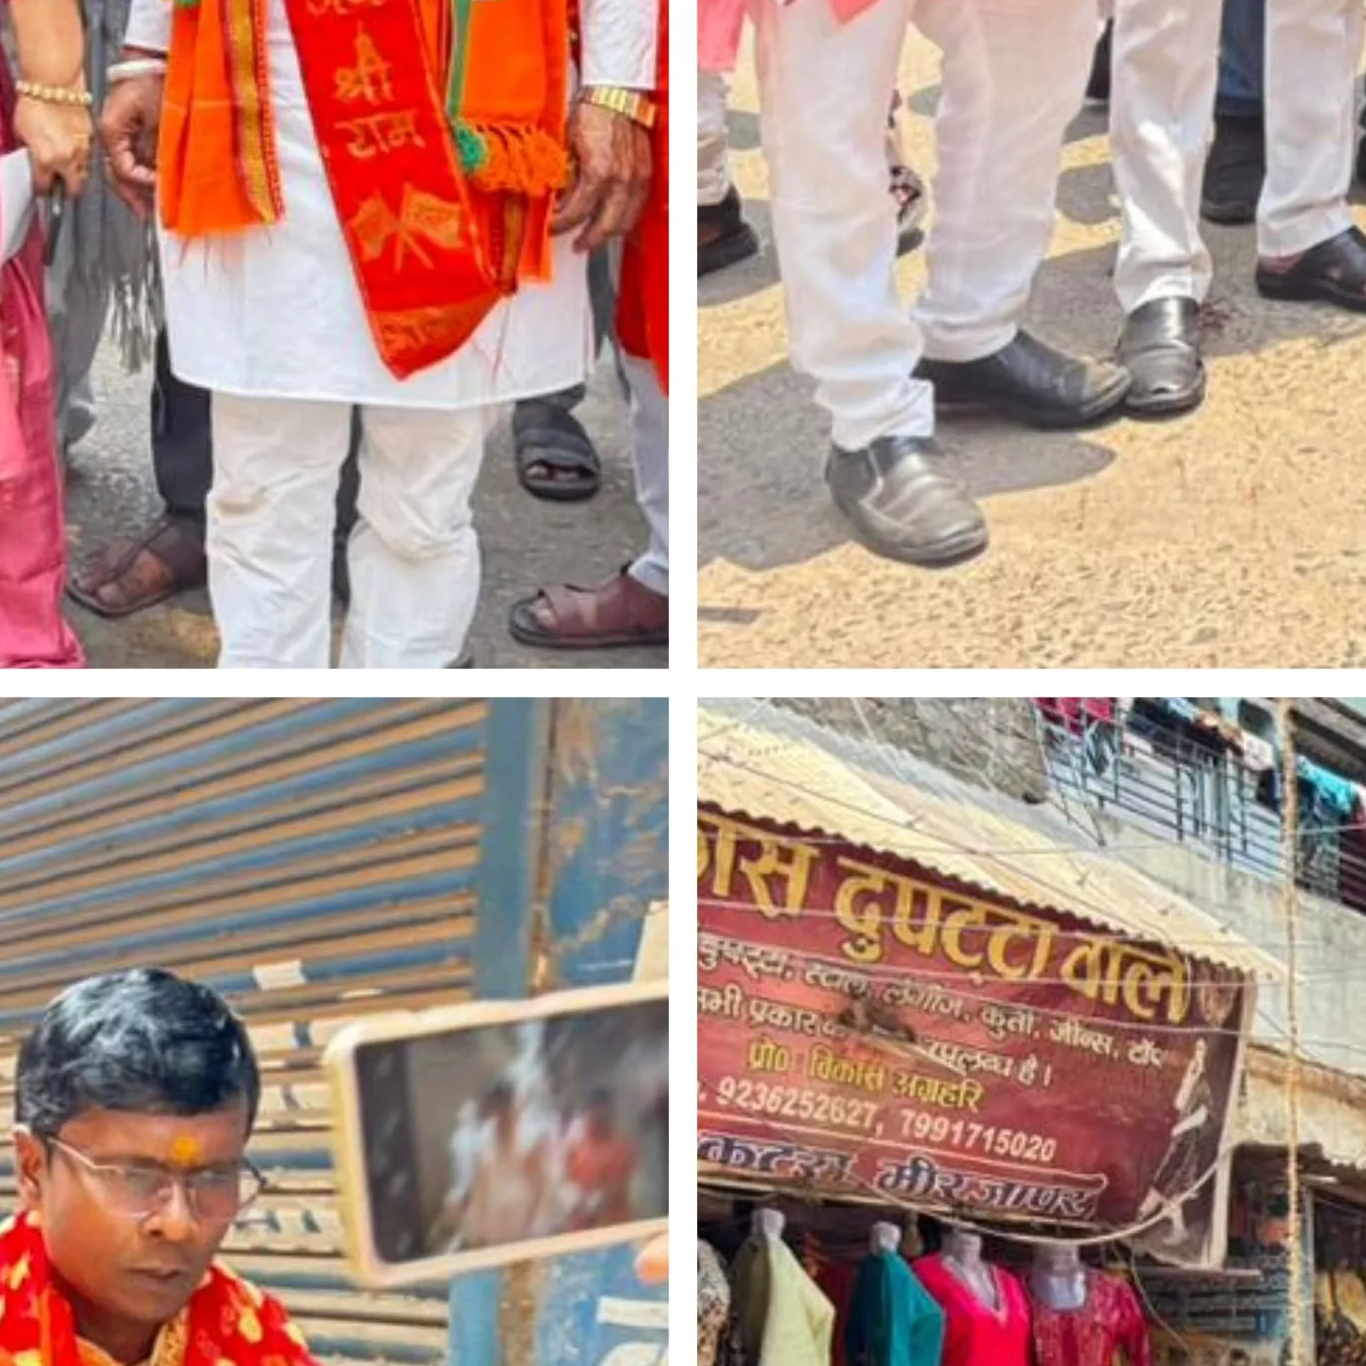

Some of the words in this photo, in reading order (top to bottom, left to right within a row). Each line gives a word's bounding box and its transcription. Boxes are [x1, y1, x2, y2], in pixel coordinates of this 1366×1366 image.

[334, 20, 395, 104] श्री
[335, 109, 426, 159] राम
[835, 855, 1061, 985] दुपट्टा
[1059, 929, 1189, 1026] वाले
[806, 1042, 885, 1092] विकास
[892, 1068, 985, 1115] अग्रहरि
[900, 1108, 1058, 1163] 7991715020
